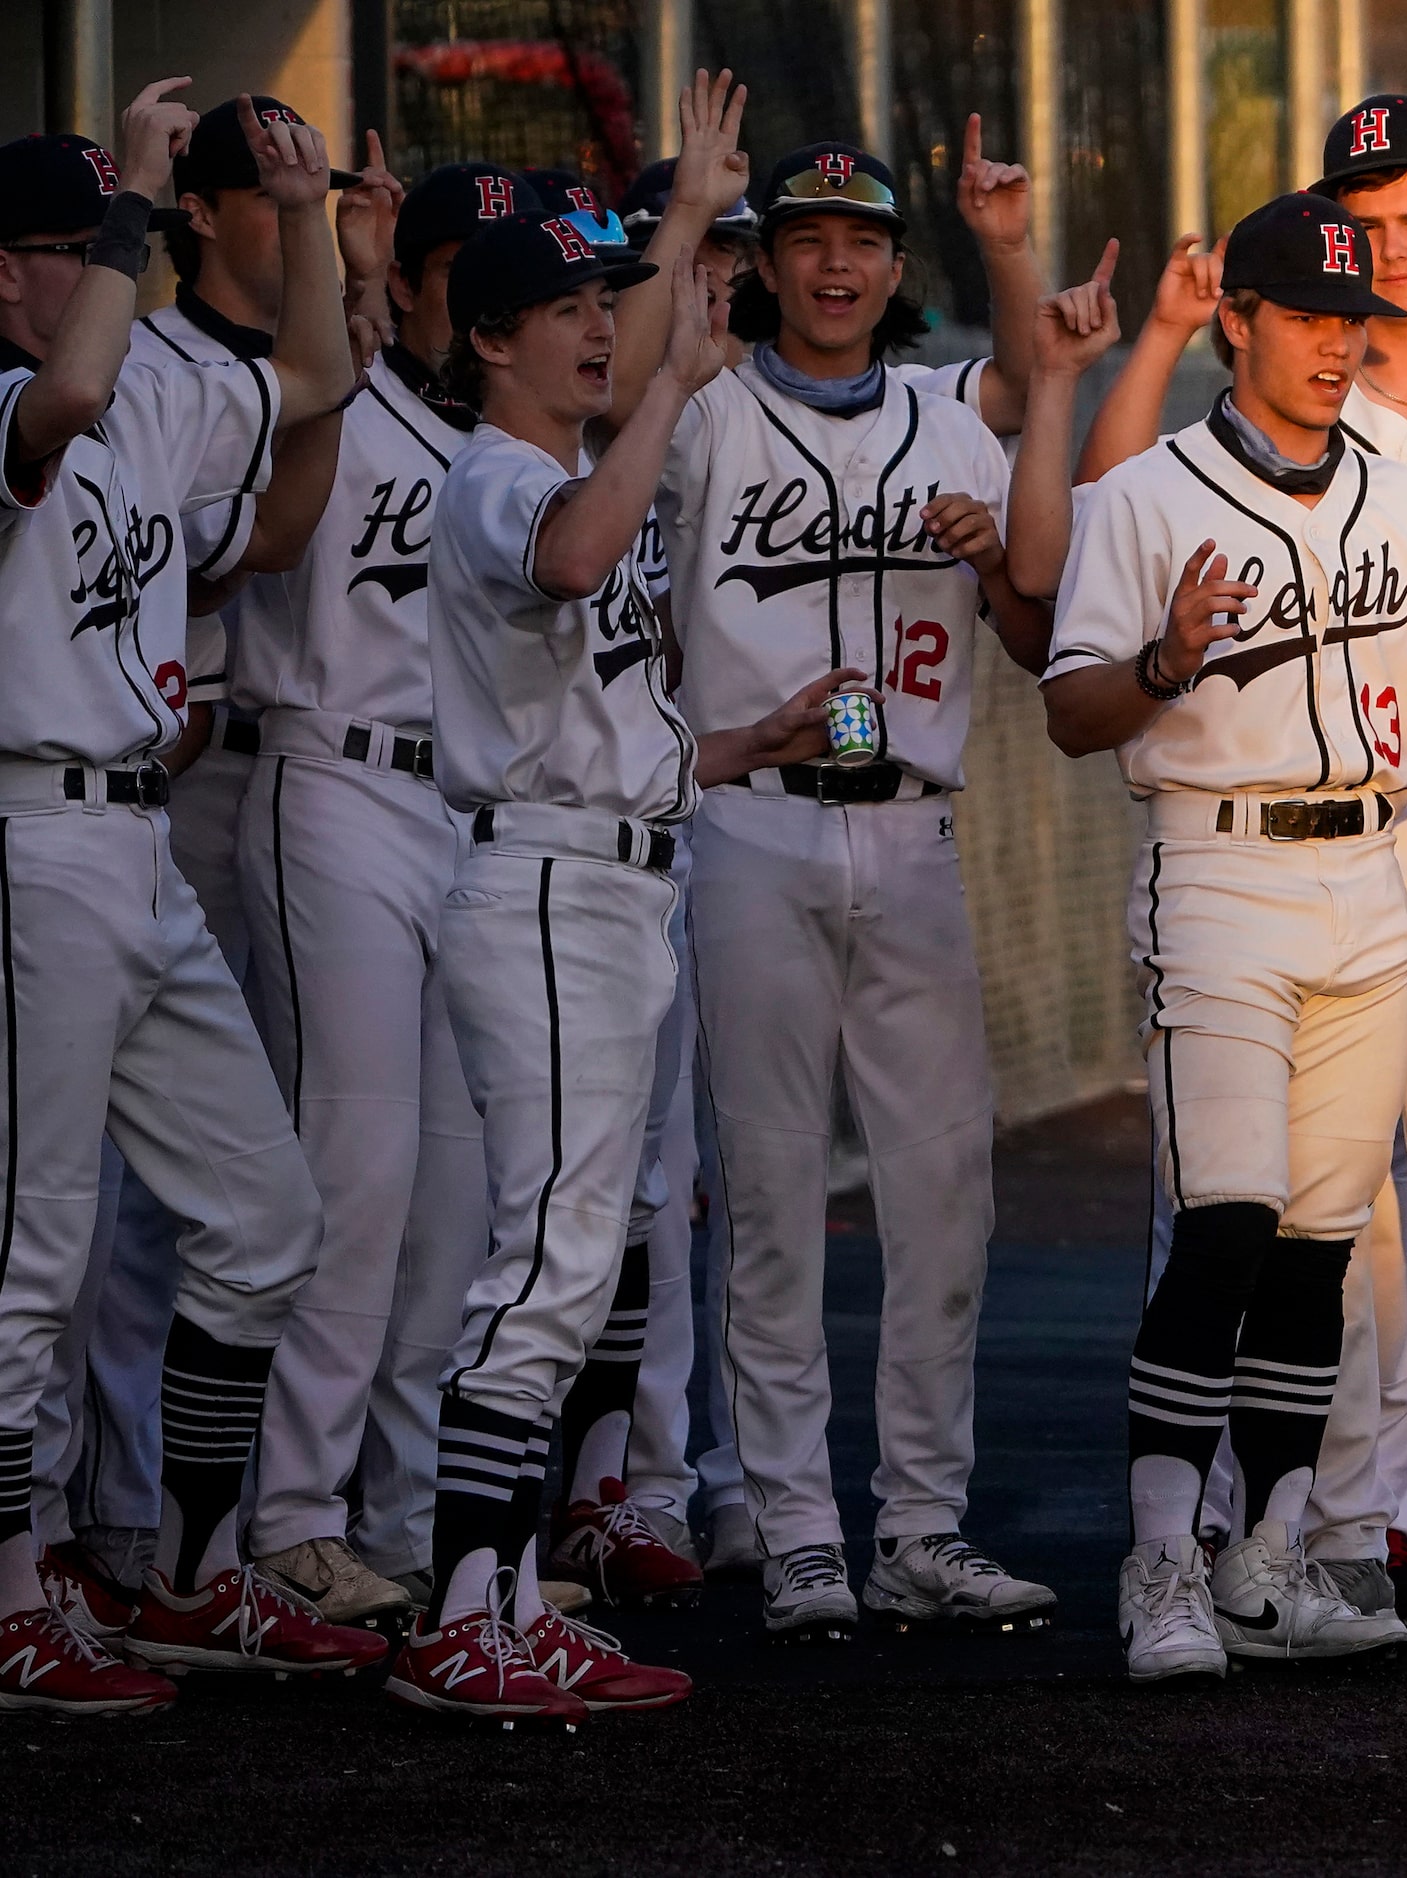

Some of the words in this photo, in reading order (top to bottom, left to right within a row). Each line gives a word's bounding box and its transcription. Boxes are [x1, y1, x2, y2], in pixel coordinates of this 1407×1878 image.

[1350, 107, 1391, 156] H
[815, 153, 855, 188] H
[475, 175, 515, 220] H
[540, 217, 597, 264] H
[1320, 223, 1361, 276] H
[884, 613, 950, 703] 12
[1360, 682, 1401, 769] 13
